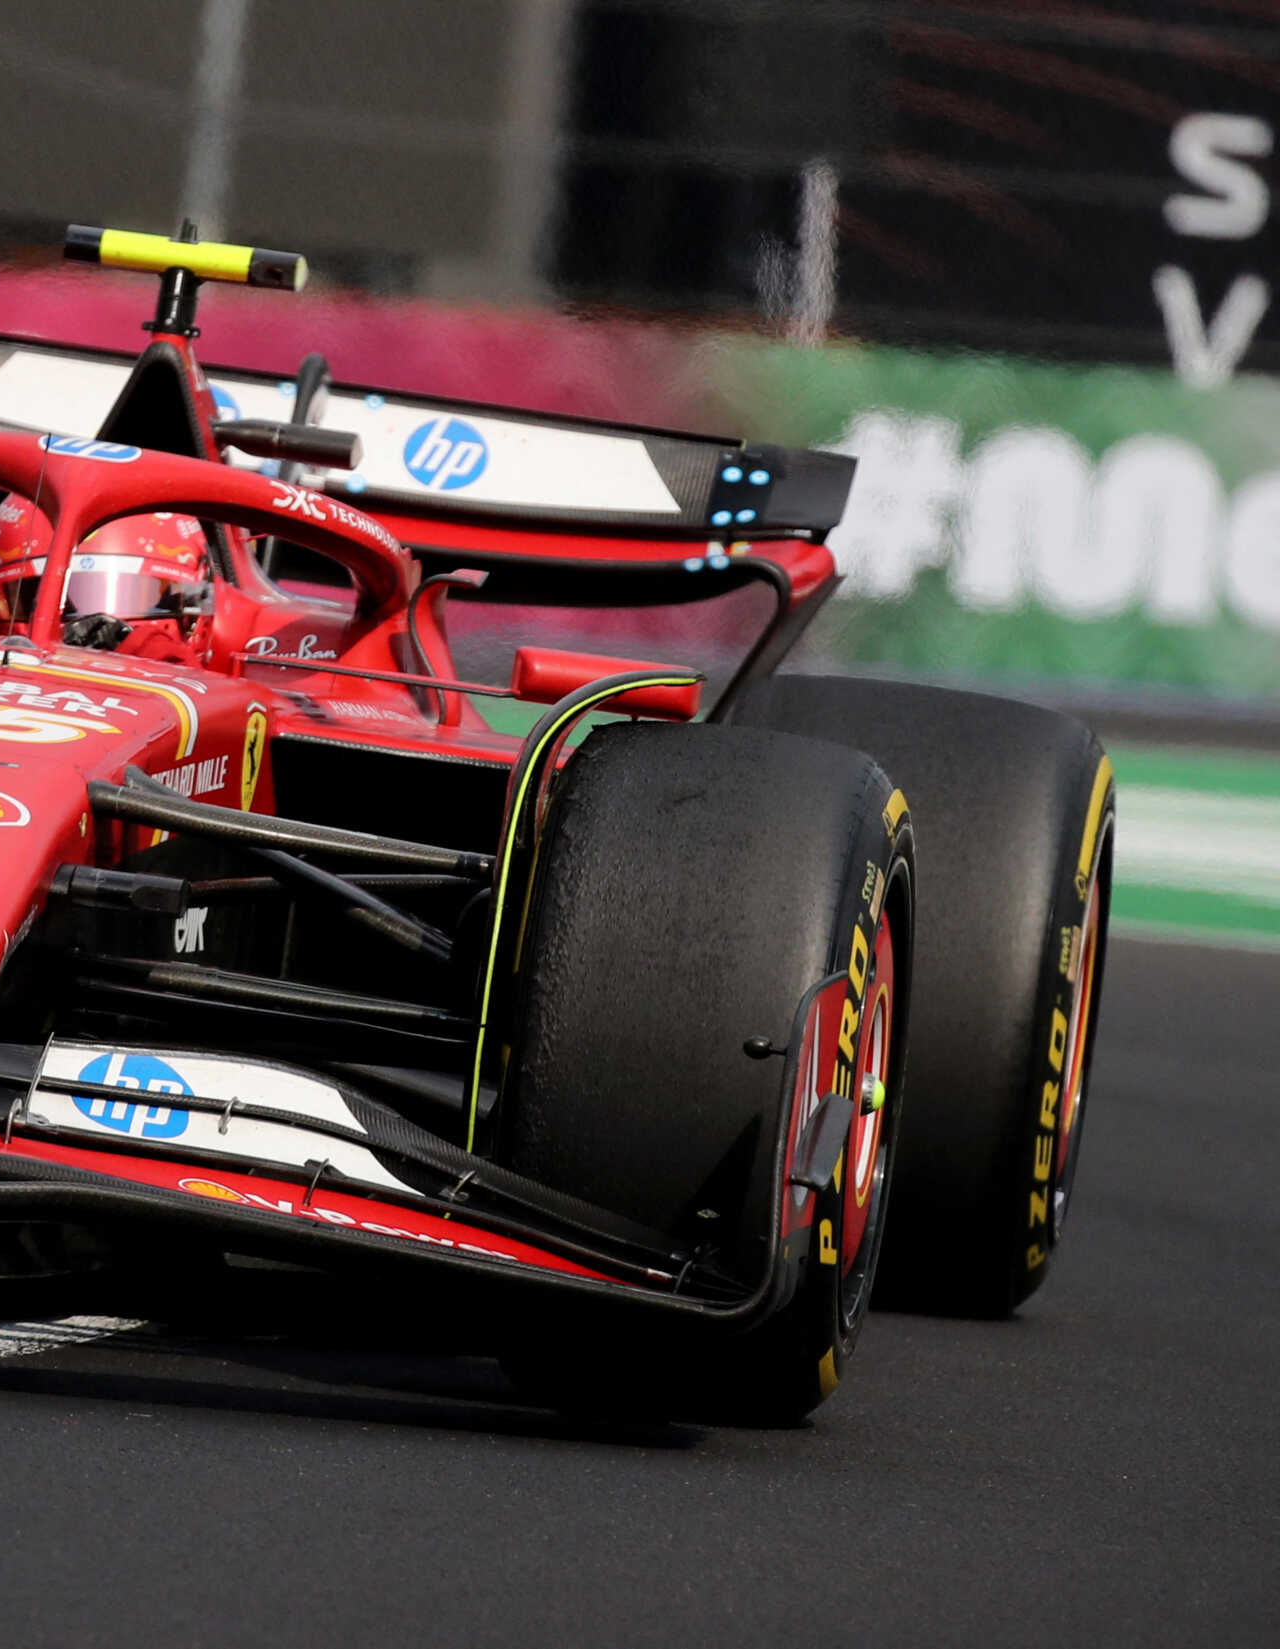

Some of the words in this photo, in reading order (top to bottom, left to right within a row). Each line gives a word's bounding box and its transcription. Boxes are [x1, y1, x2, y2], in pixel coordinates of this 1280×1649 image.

[404, 416, 489, 490] hp
[194, 754, 230, 796] MILLE
[84, 1053, 188, 1138] hp
[1029, 1006, 1069, 1229] ZERO
